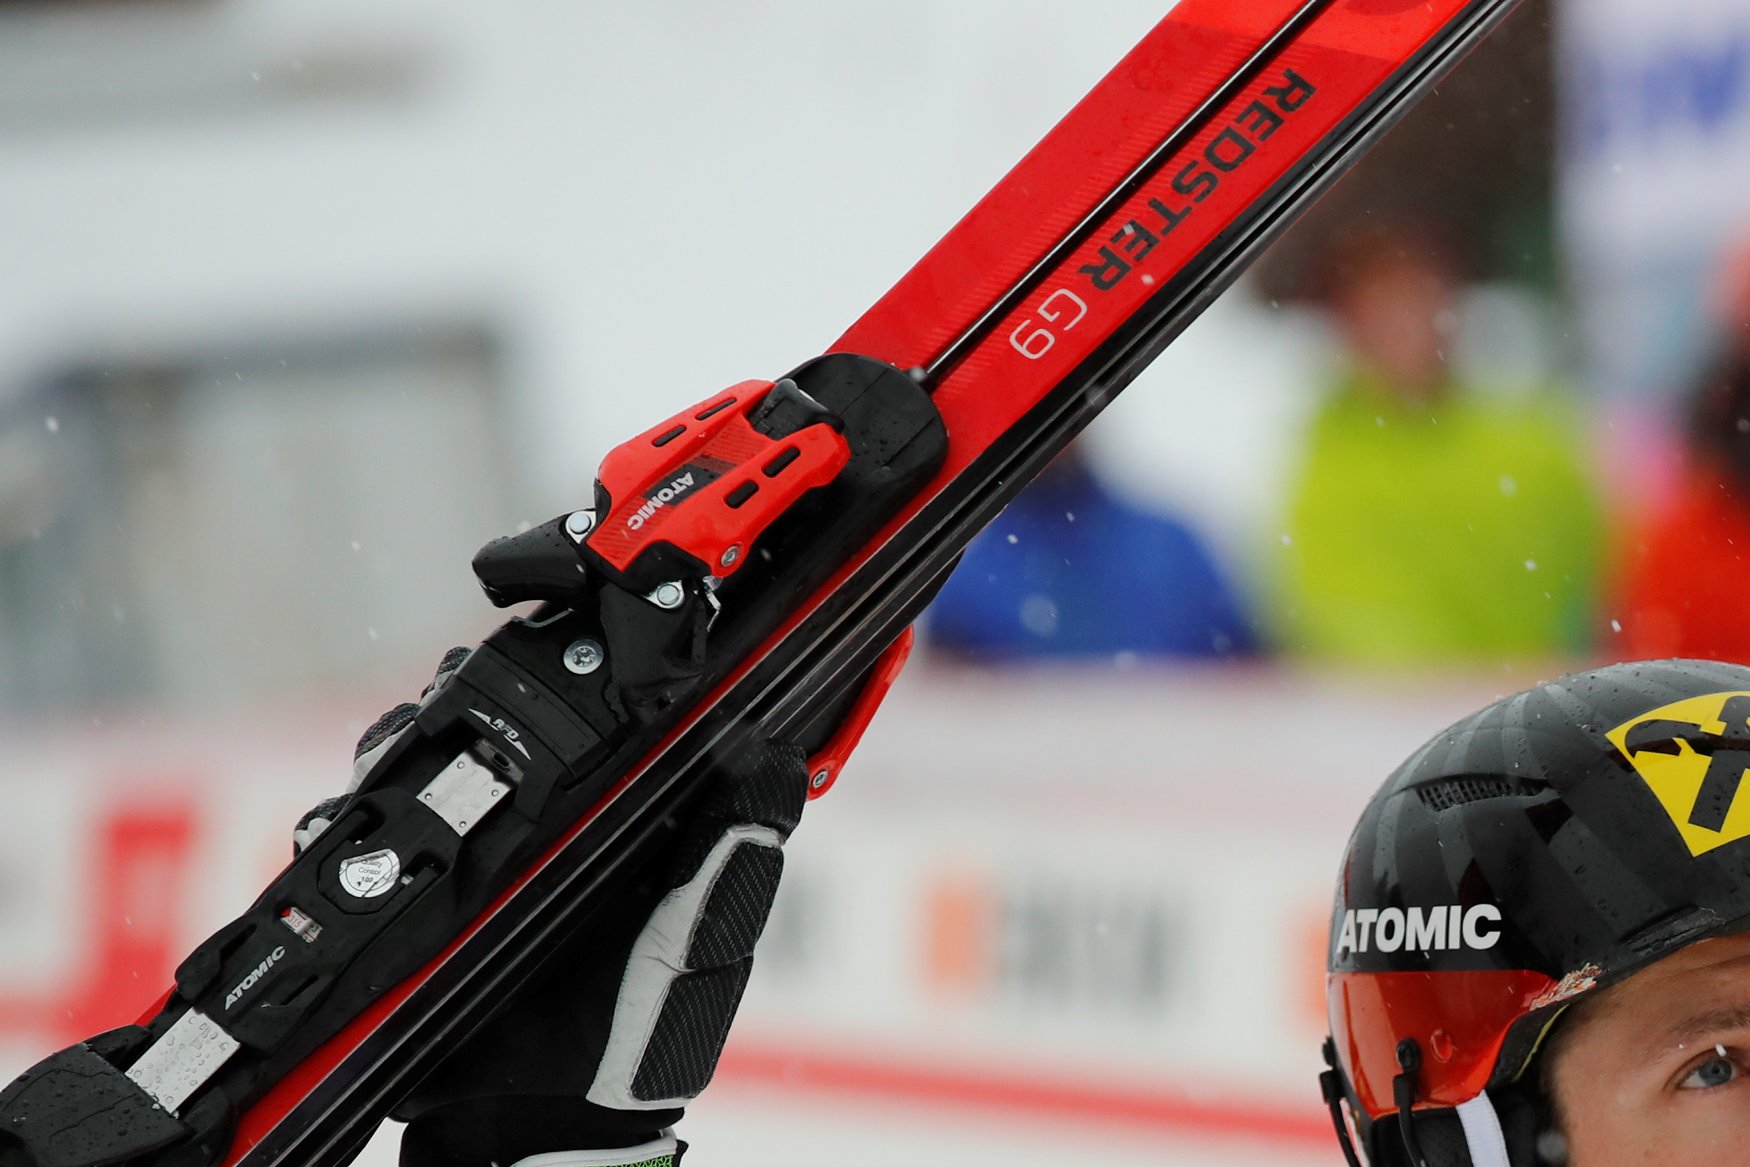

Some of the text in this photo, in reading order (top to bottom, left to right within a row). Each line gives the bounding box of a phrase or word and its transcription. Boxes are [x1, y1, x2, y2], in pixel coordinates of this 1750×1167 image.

[1009, 67, 1317, 360] REDSTER G9
[627, 472, 695, 531] ATOMIC
[1336, 903, 1502, 954] ATOMIC
[225, 945, 286, 1011] ATOMIC
